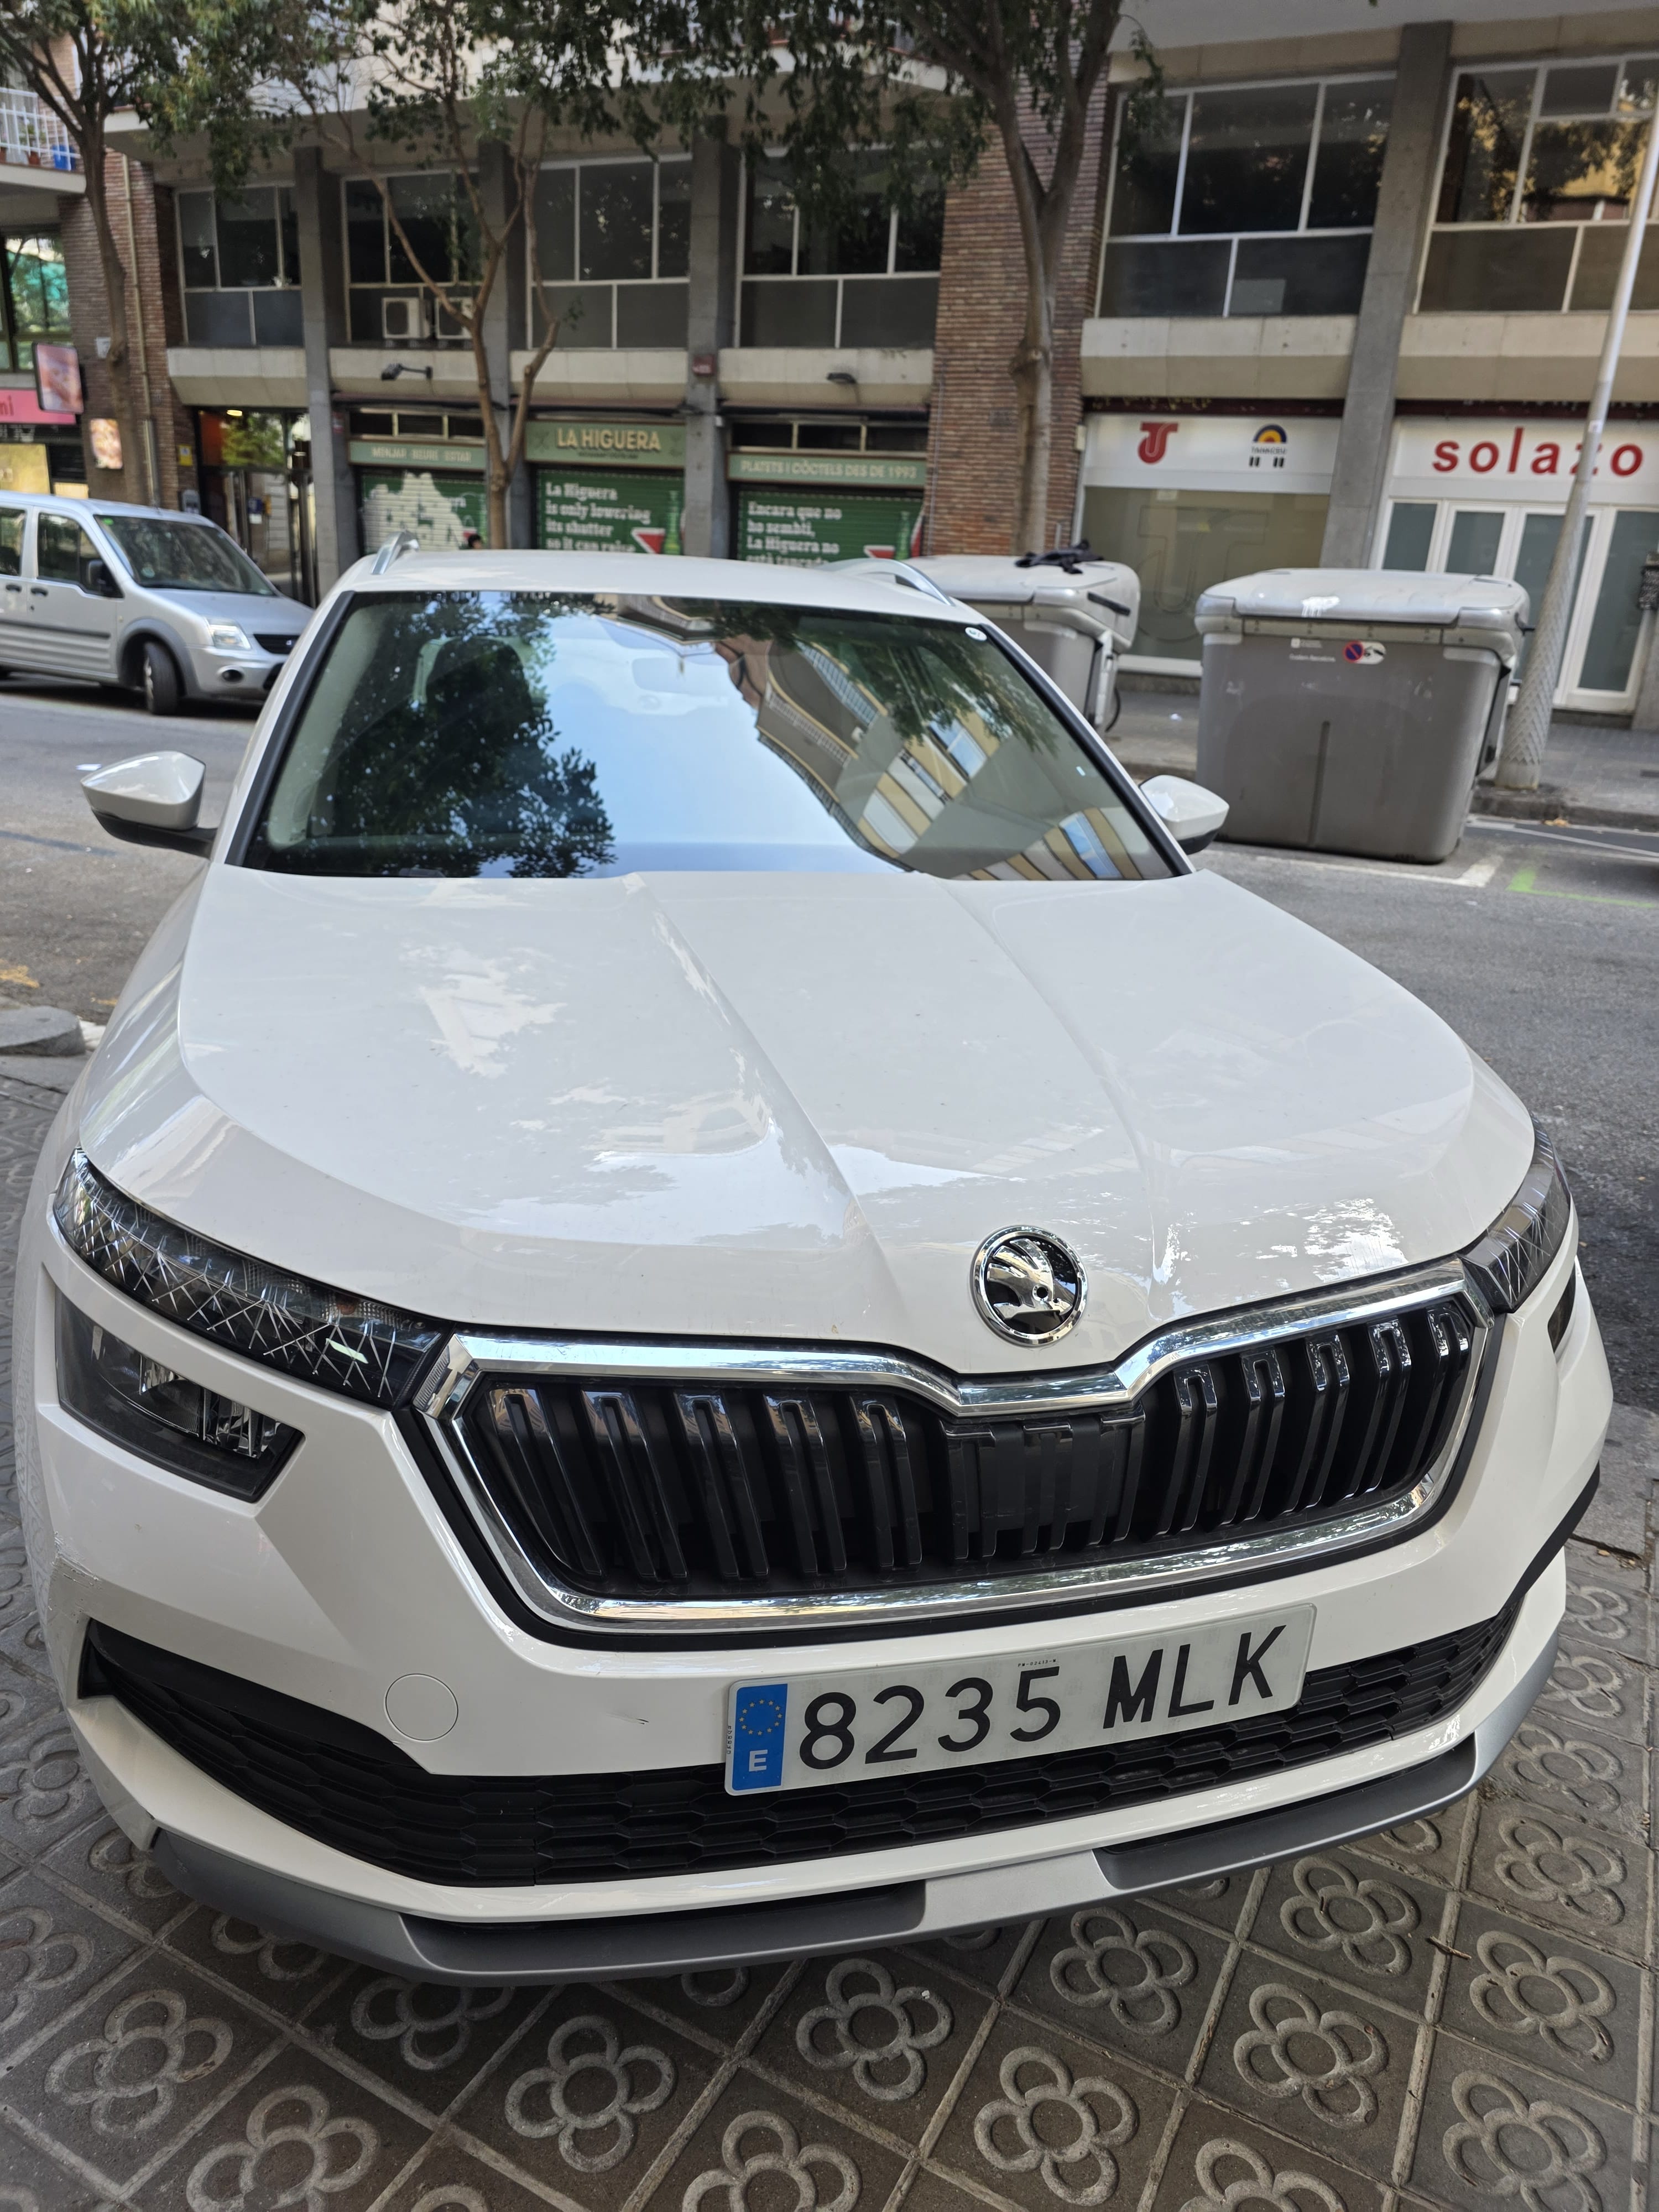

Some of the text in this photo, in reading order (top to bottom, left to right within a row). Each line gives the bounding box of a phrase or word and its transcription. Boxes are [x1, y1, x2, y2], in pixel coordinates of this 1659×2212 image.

[557, 427, 661, 451] LA HIGUERA
[371, 447, 407, 459] MENJAR
[845, 463, 867, 478] DES
[870, 465, 885, 478] DE
[545, 482, 618, 501] La Higuera
[545, 500, 652, 525] is only lowering
[748, 500, 843, 521] Encara que no
[545, 517, 614, 538] its shutter
[747, 519, 764, 534] ho
[747, 535, 841, 555] La Higuera no
[799, 1624, 1287, 1770] 8235 MLK
[748, 1749, 768, 1772] E
